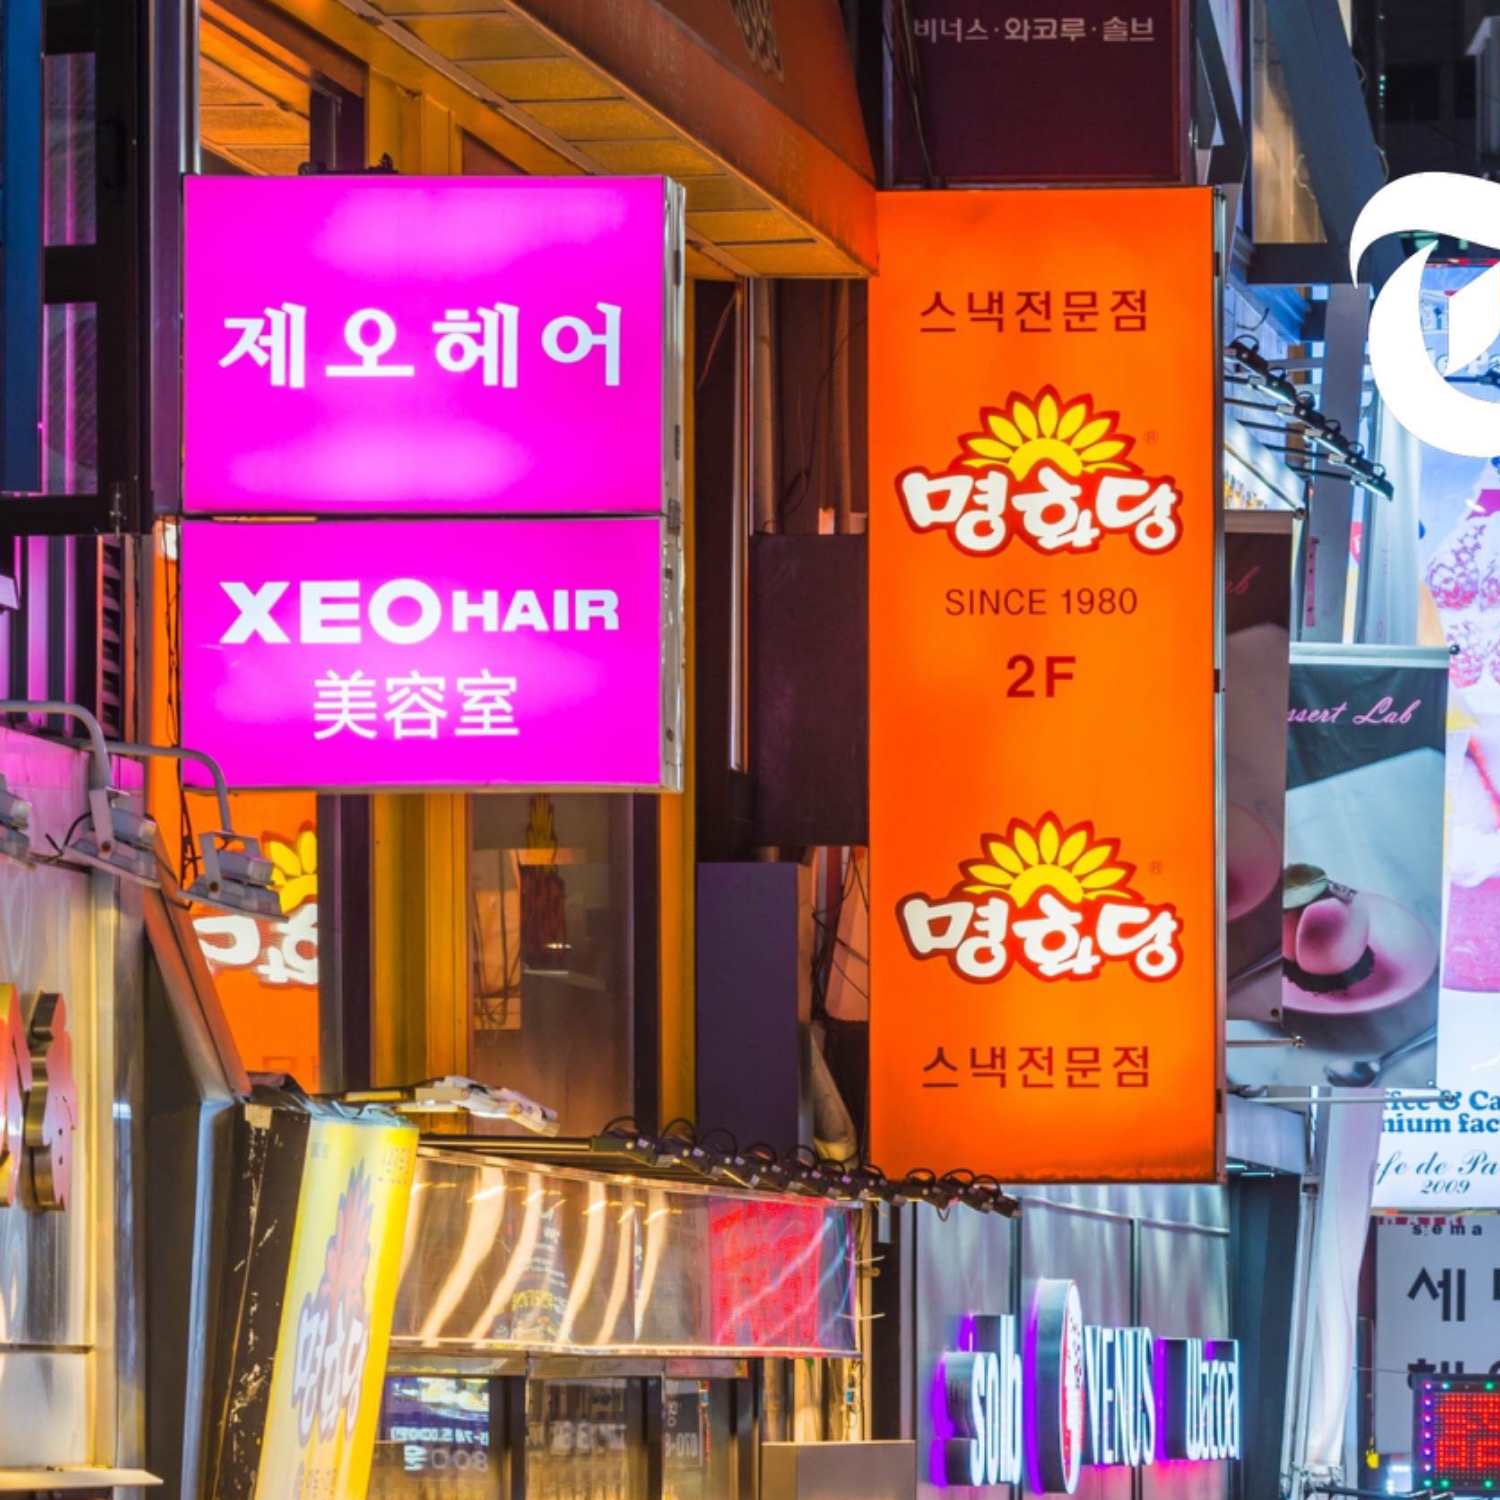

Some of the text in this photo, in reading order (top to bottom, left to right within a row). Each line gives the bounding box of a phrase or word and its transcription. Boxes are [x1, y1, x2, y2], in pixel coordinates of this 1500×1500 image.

[919, 289, 1148, 334] 스낵전문점
[219, 302, 622, 388] 제오헤어
[219, 578, 620, 645] XEO HAIR
[945, 588, 1139, 617] SINCE 1980
[1005, 654, 1077, 699] 2F
[312, 669, 520, 741] 美容室
[921, 1044, 1151, 1089] 스낵전문점
[1420, 1179, 1471, 1196] 2009
[1083, 1324, 1156, 1466] VENUS
